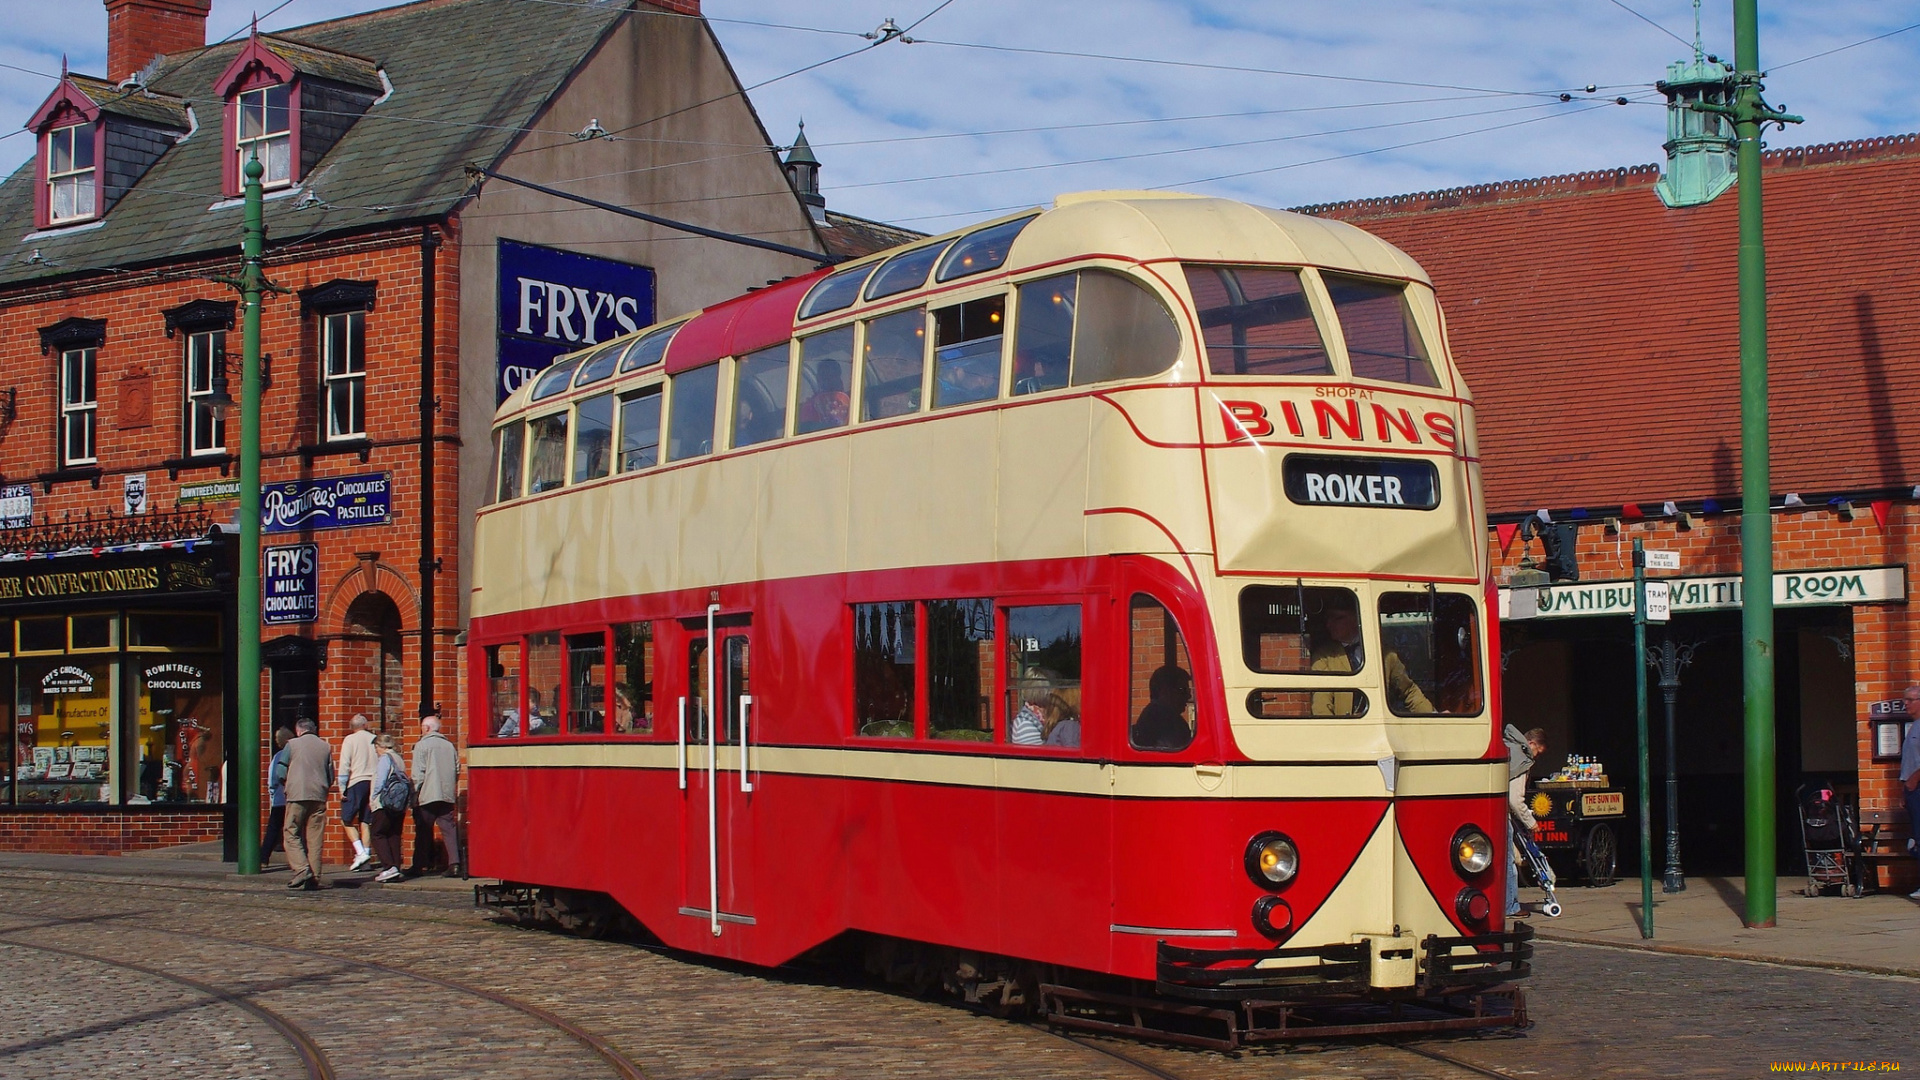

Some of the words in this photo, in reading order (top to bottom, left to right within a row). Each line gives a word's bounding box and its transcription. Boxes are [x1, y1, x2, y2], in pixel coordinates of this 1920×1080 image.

[516, 277, 638, 345] FRY'S
[1315, 386, 1356, 398] SHOP
[1358, 388, 1375, 400] AT
[1219, 399, 1457, 451] BINNS
[214, 483, 241, 495] CHOCOLA
[336, 480, 386, 498] CHOCOLATES
[1305, 472, 1405, 505] ROKER
[263, 487, 337, 526] Rowntree's
[337, 504, 386, 520] PASTILLES
[267, 548, 313, 578] FRY'S
[0, 576, 24, 599] EE
[26, 566, 161, 597] CONFECTIONERS
[275, 578, 305, 593] MILK
[1538, 587, 1635, 612] OMNIBU
[1785, 574, 1867, 600] ROOM
[1647, 590, 1668, 599] TRAM
[266, 595, 315, 612] CHOCOLATE
[1649, 604, 1667, 613] STOP
[60, 665, 95, 686] CHOCOLATE
[145, 664, 202, 678] ROWNTREE'S
[147, 680, 202, 690] CHOCOLATES
[57, 707, 98, 719] Manufacture
[98, 706, 109, 716] Of
[1585, 796, 1597, 805] THE
[1597, 794, 1609, 804] SUN
[1536, 820, 1555, 831] HE
[1546, 832, 1568, 842] INN
